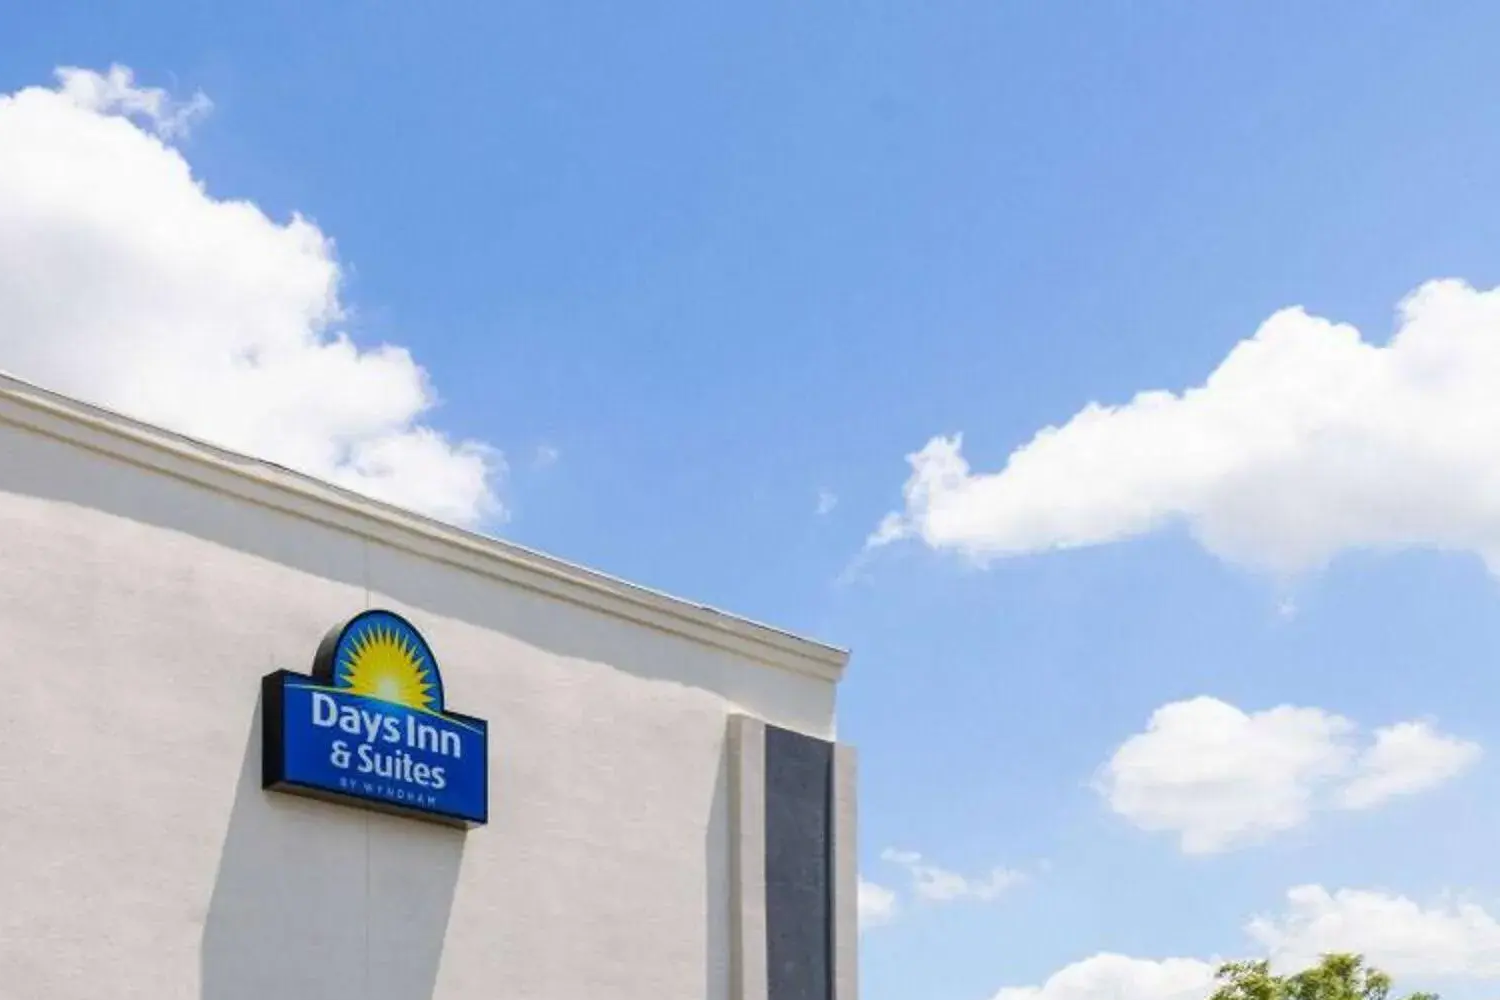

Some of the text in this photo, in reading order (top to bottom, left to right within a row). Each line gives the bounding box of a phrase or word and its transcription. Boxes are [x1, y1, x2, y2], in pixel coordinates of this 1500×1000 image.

[311, 691, 461, 758] Days Inn
[329, 739, 446, 789] & Suites
[339, 776, 437, 808] BY WYNDHAM
